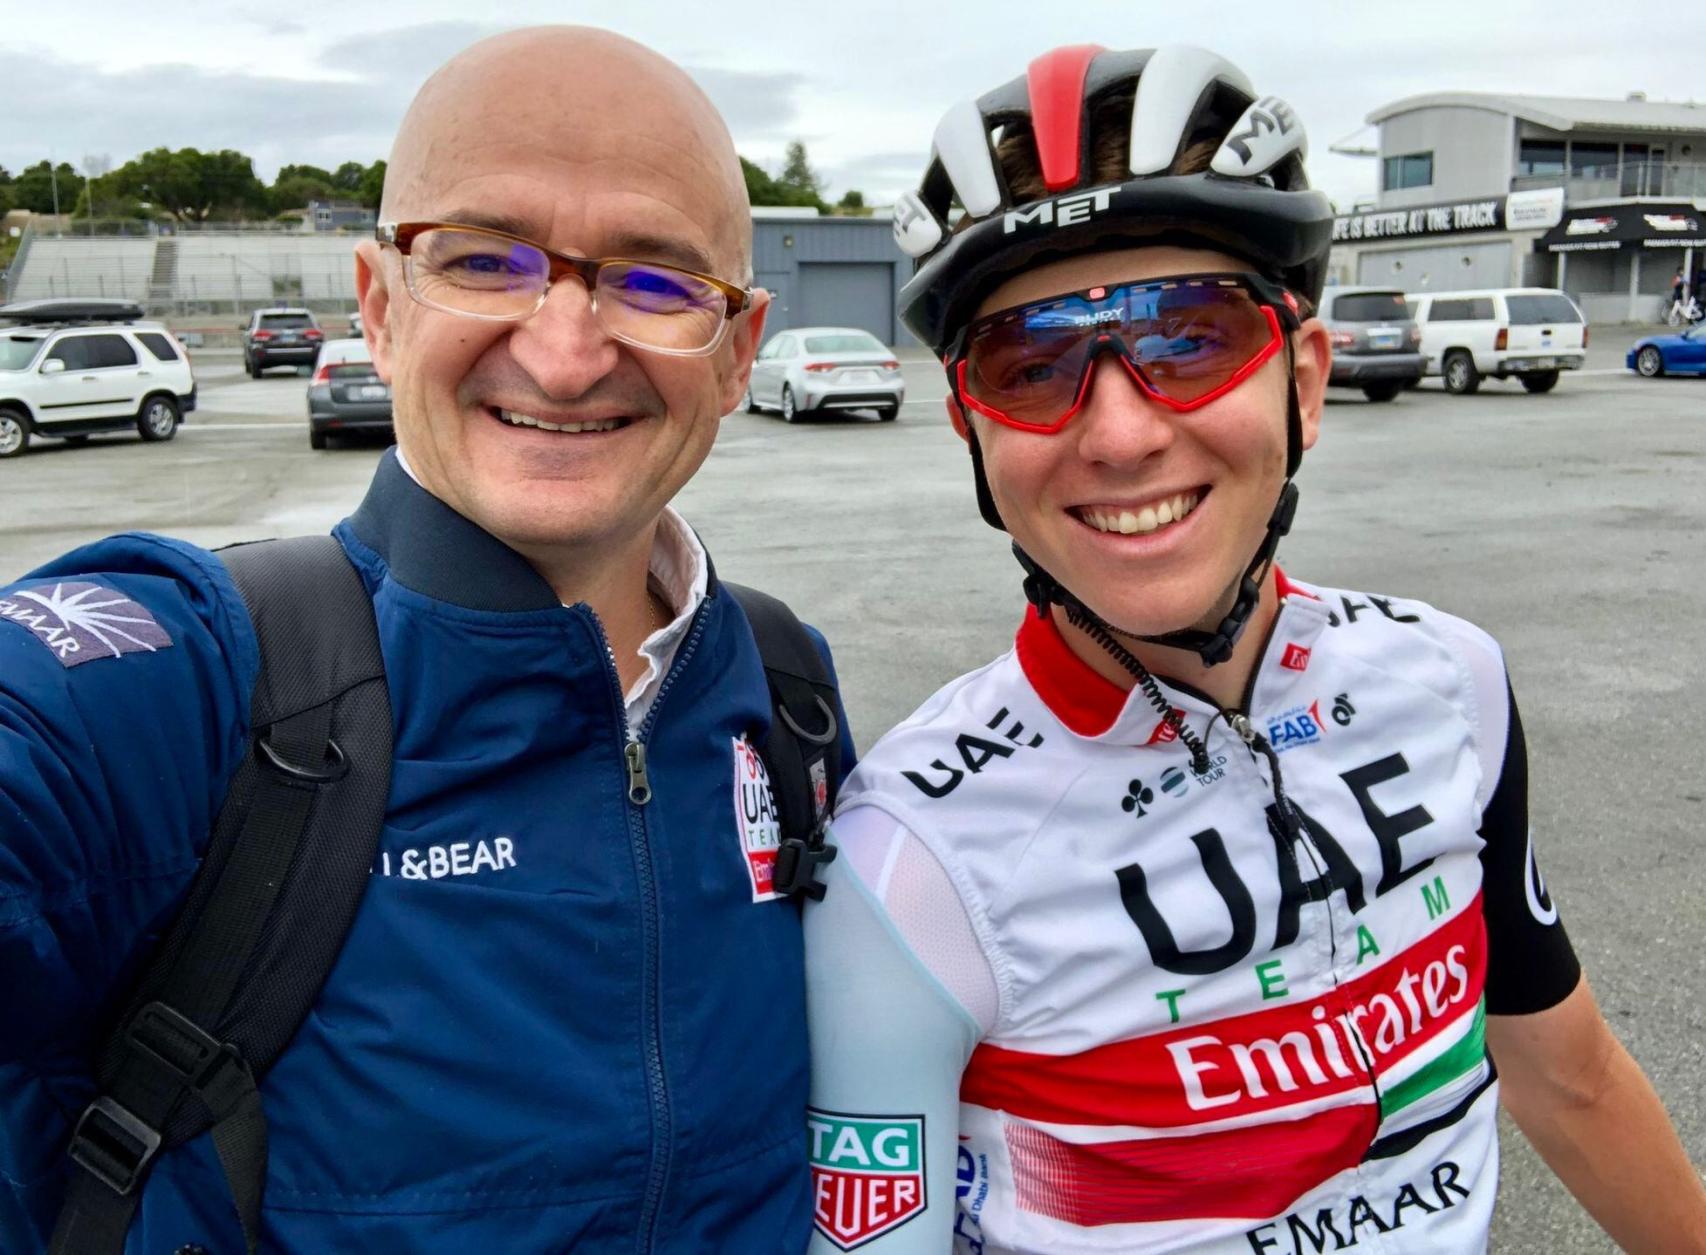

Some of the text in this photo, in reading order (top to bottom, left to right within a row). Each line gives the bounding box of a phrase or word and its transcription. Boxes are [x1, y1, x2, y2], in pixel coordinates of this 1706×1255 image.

[1004, 186, 1121, 234] MET
[1363, 211, 1408, 238] BETTER
[1408, 208, 1427, 233] AT
[1427, 206, 1451, 232] THE
[1453, 201, 1498, 229] TRACK
[900, 706, 1045, 799] UAE
[1268, 715, 1318, 747] FAB
[1196, 767, 1226, 787] TOUR
[1114, 751, 1448, 976] UAE
[1164, 944, 1469, 1112] Emirates
[807, 1119, 910, 1168] TAG
[1246, 1161, 1470, 1255] EMAAR
